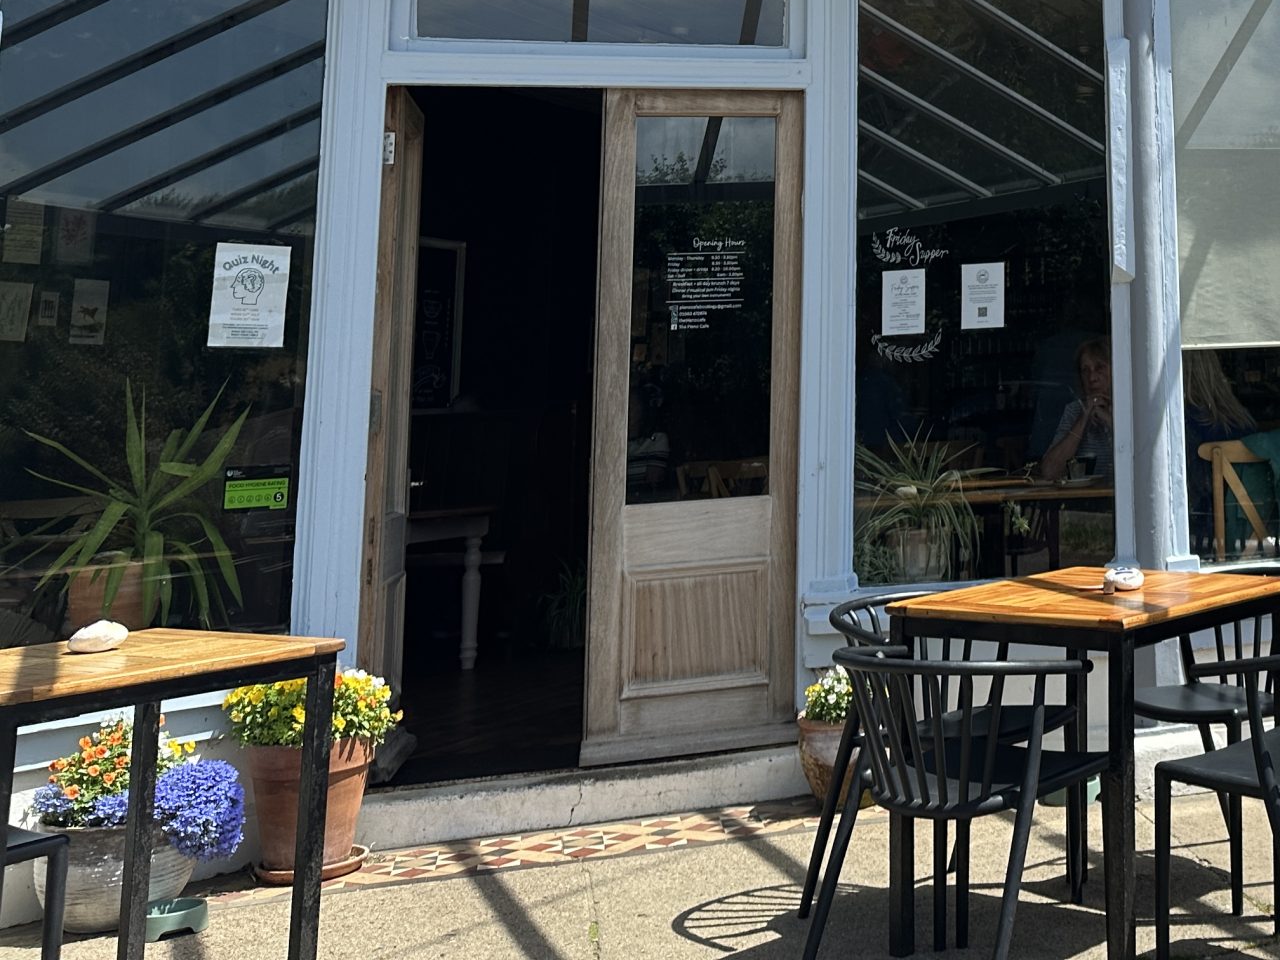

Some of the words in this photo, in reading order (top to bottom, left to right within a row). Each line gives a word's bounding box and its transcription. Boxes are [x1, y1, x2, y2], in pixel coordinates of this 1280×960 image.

[693, 237, 723, 251] Opening
[725, 237, 745, 247] Hours
[885, 226, 920, 257] Friday
[222, 254, 249, 271] Quiz
[251, 254, 280, 274] Night
[909, 242, 949, 267] Supper
[275, 493, 282, 502] 5
